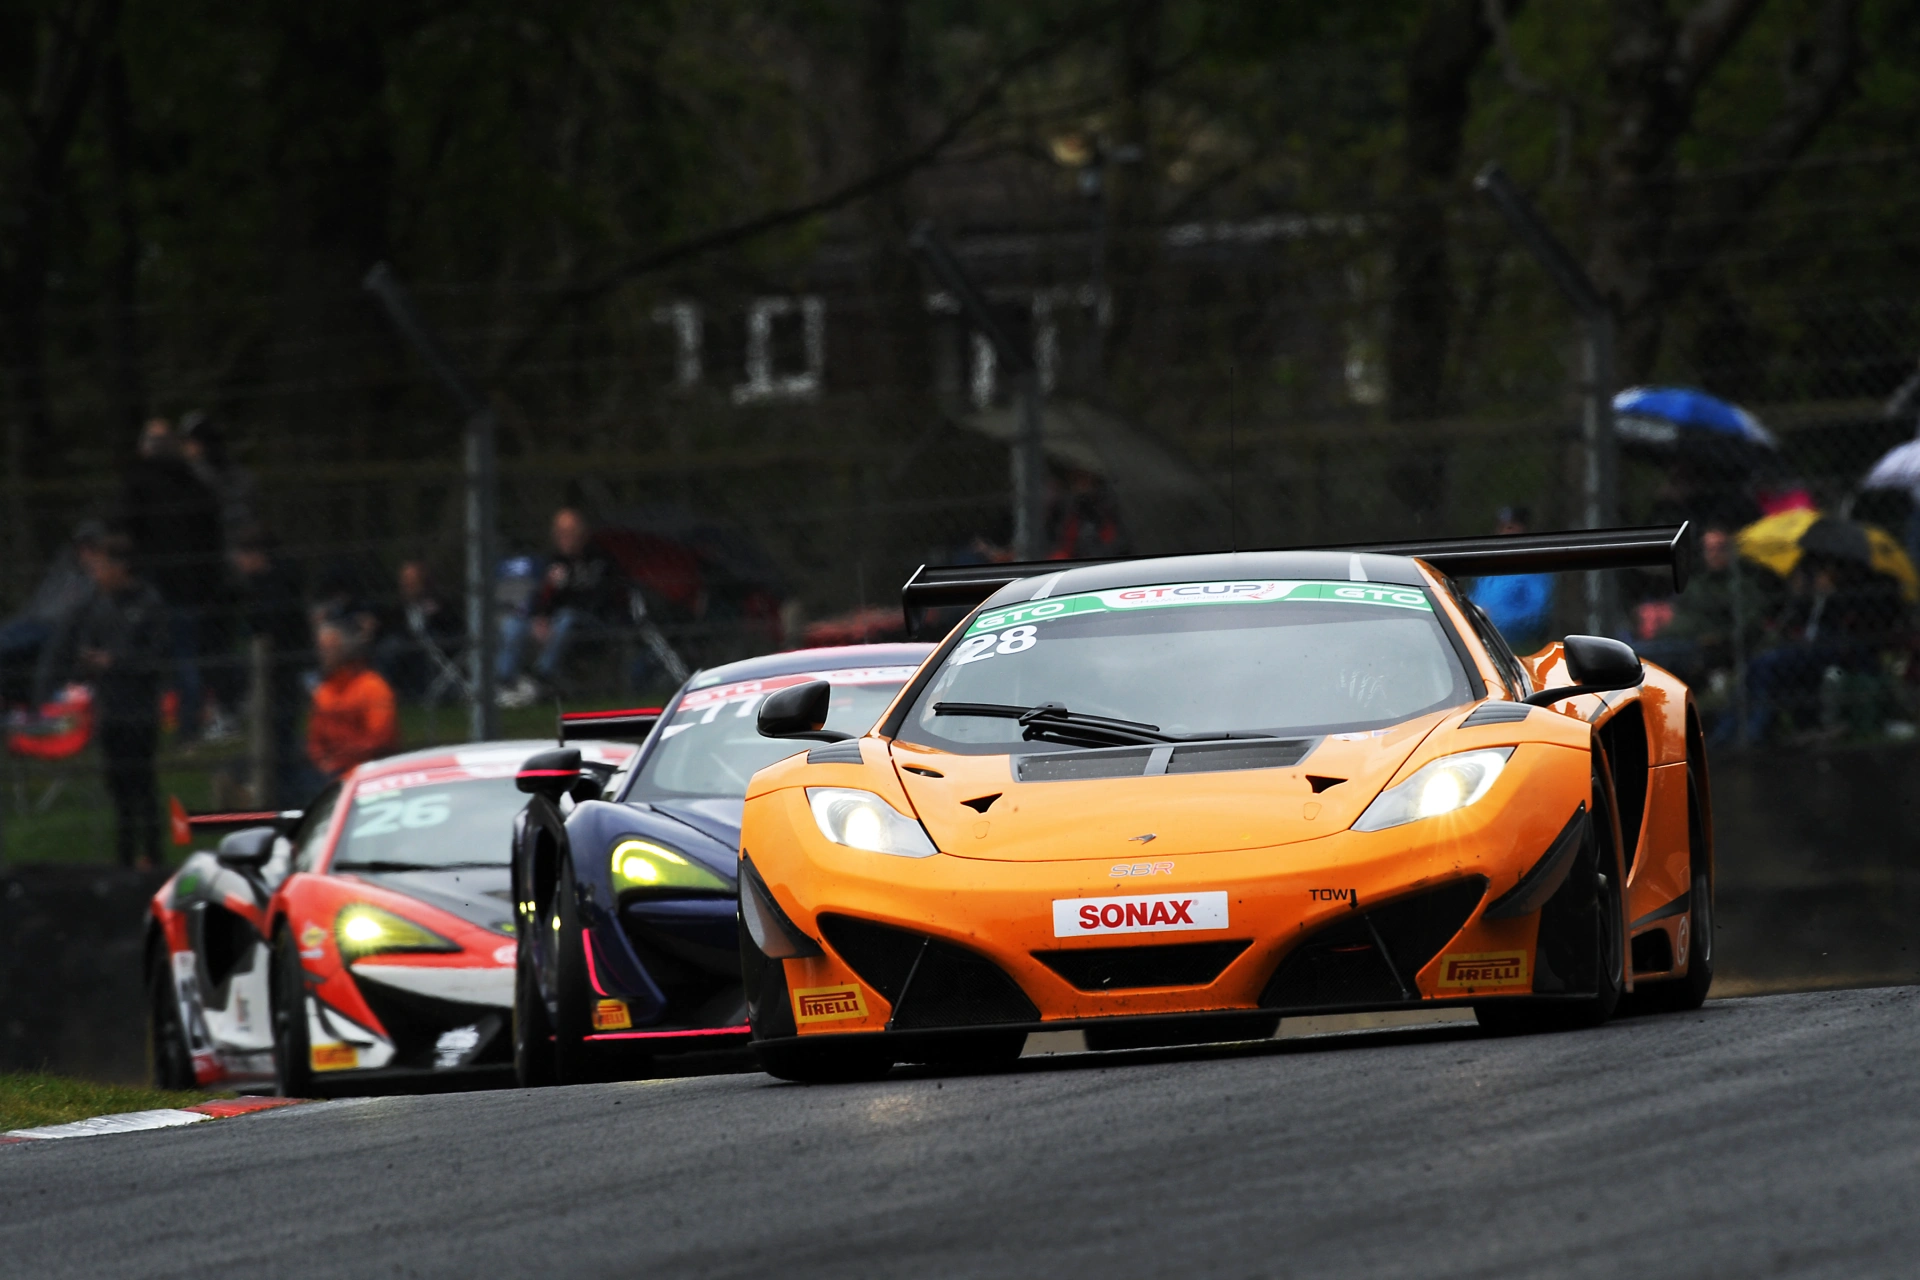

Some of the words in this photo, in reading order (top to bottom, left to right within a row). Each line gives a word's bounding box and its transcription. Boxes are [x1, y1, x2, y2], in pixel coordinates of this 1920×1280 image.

[975, 603, 1065, 629] GTO
[1334, 588, 1427, 605] GTO
[955, 625, 1038, 666] 28
[691, 694, 765, 725] 77
[352, 793, 452, 838] 26
[1109, 861, 1175, 878] SBR
[1308, 888, 1349, 901] TOW
[1079, 899, 1194, 929] SONAX
[1447, 957, 1521, 981] PIRELLI
[799, 991, 860, 1017] PIRELLI
